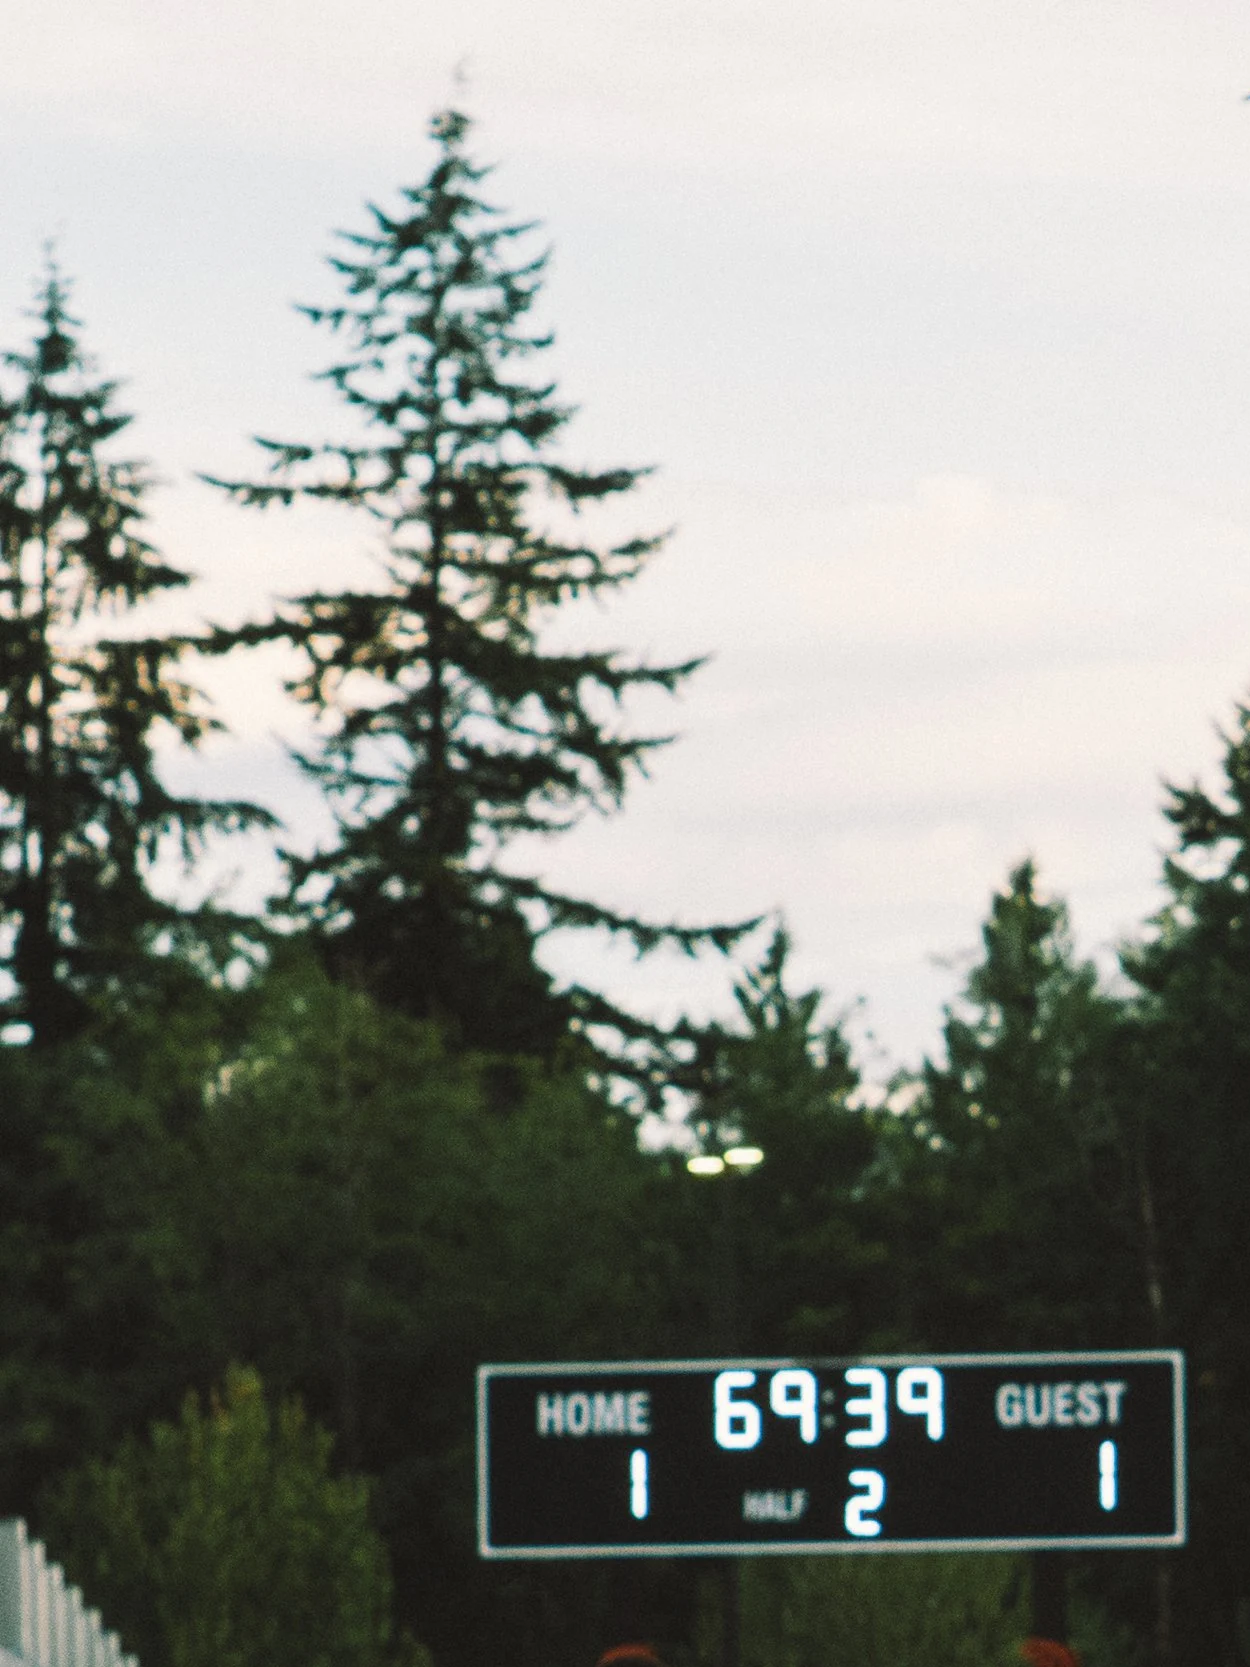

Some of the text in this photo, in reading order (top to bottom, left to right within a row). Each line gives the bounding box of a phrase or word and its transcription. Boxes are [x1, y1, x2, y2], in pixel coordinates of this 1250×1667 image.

[537, 1391, 652, 1437] HOME
[713, 1366, 945, 1449] 69:39
[995, 1381, 1127, 1429] GUEST
[630, 1448, 649, 1519] 1
[742, 1468, 885, 1537] HALF 2
[1099, 1439, 1118, 1512] 1
